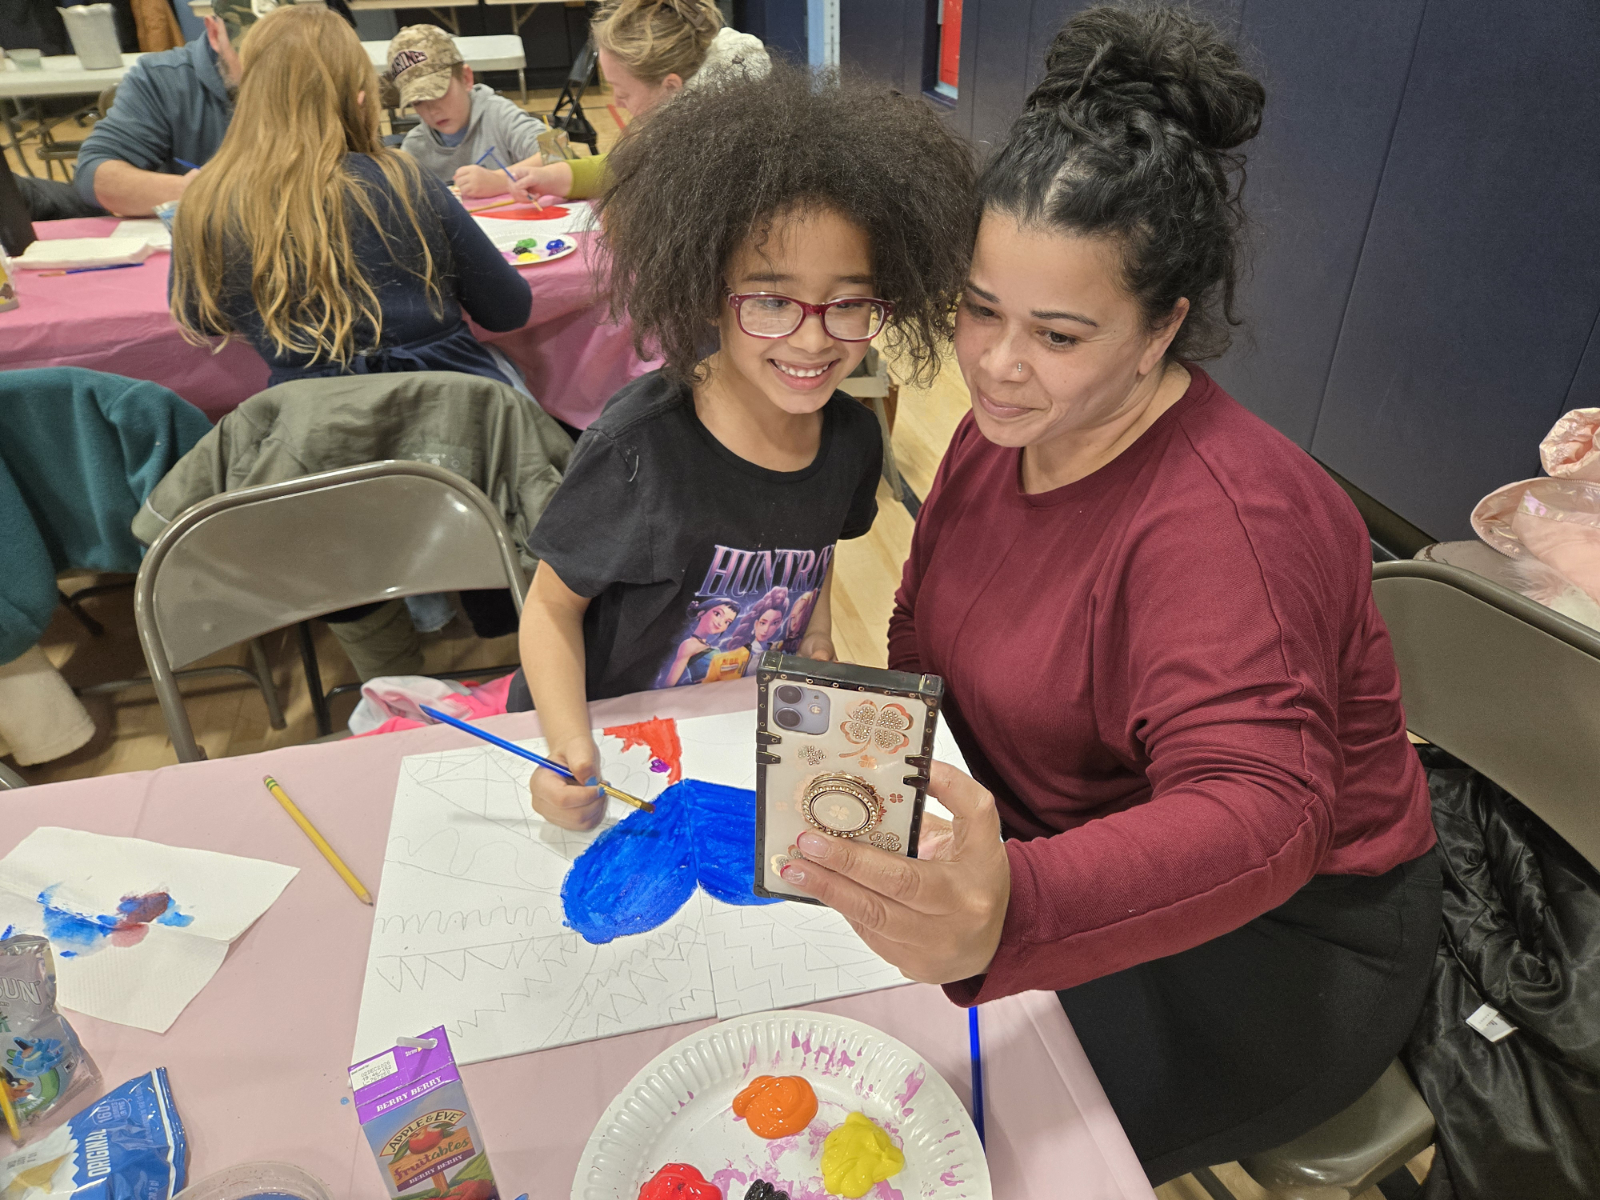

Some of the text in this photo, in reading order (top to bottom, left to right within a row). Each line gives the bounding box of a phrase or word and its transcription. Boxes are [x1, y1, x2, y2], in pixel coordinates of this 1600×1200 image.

[0, 977, 42, 1006] UN
[376, 1092, 409, 1113] BERRY
[410, 1076, 442, 1096] BERRY
[96, 1105, 113, 1124] 160
[389, 1111, 459, 1153] APPLE & EVE
[84, 1128, 112, 1178] ORIGINAL
[394, 1138, 469, 1180] fruitables
[409, 1154, 463, 1185] BERRY BERRY
